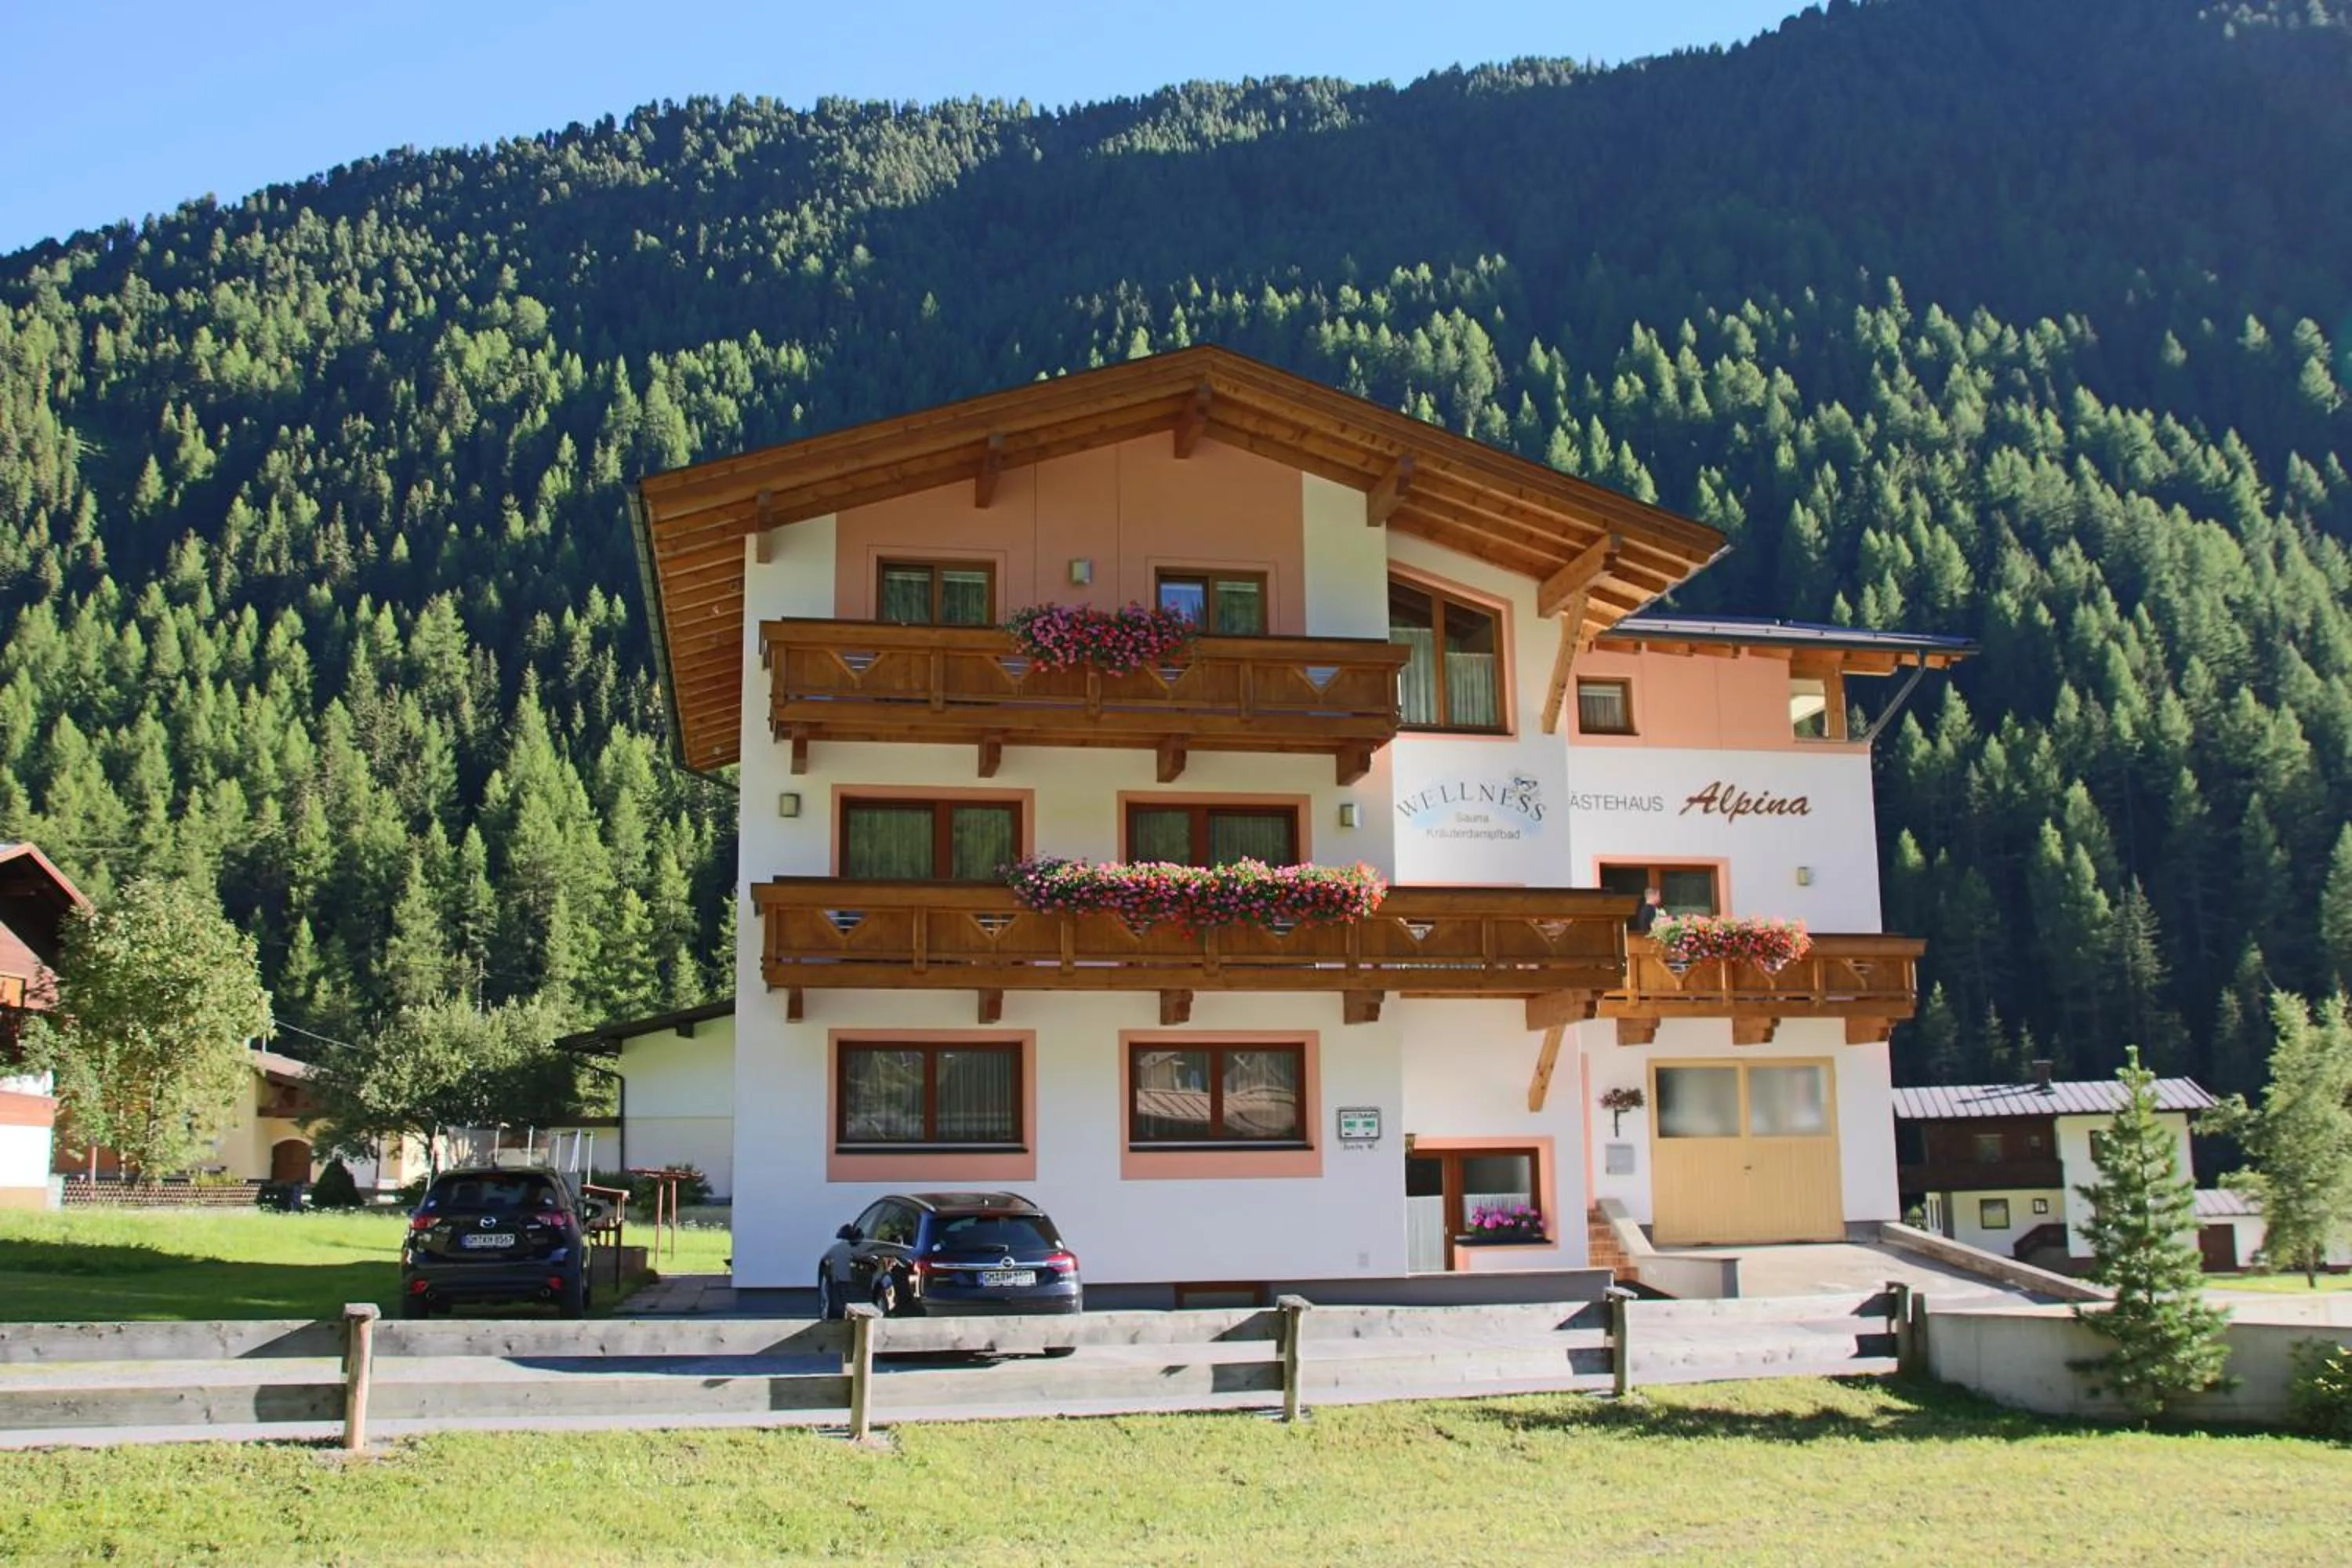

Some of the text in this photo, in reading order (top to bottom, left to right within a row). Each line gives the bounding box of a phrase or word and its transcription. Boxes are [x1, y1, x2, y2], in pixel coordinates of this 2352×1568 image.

[1396, 782, 1547, 822] WELLNESS
[1568, 781, 1812, 824] ÄSTEHAUS Alpina
[1455, 811, 1490, 822] Sauna
[1426, 827, 1521, 840] Kräuterdampfbad
